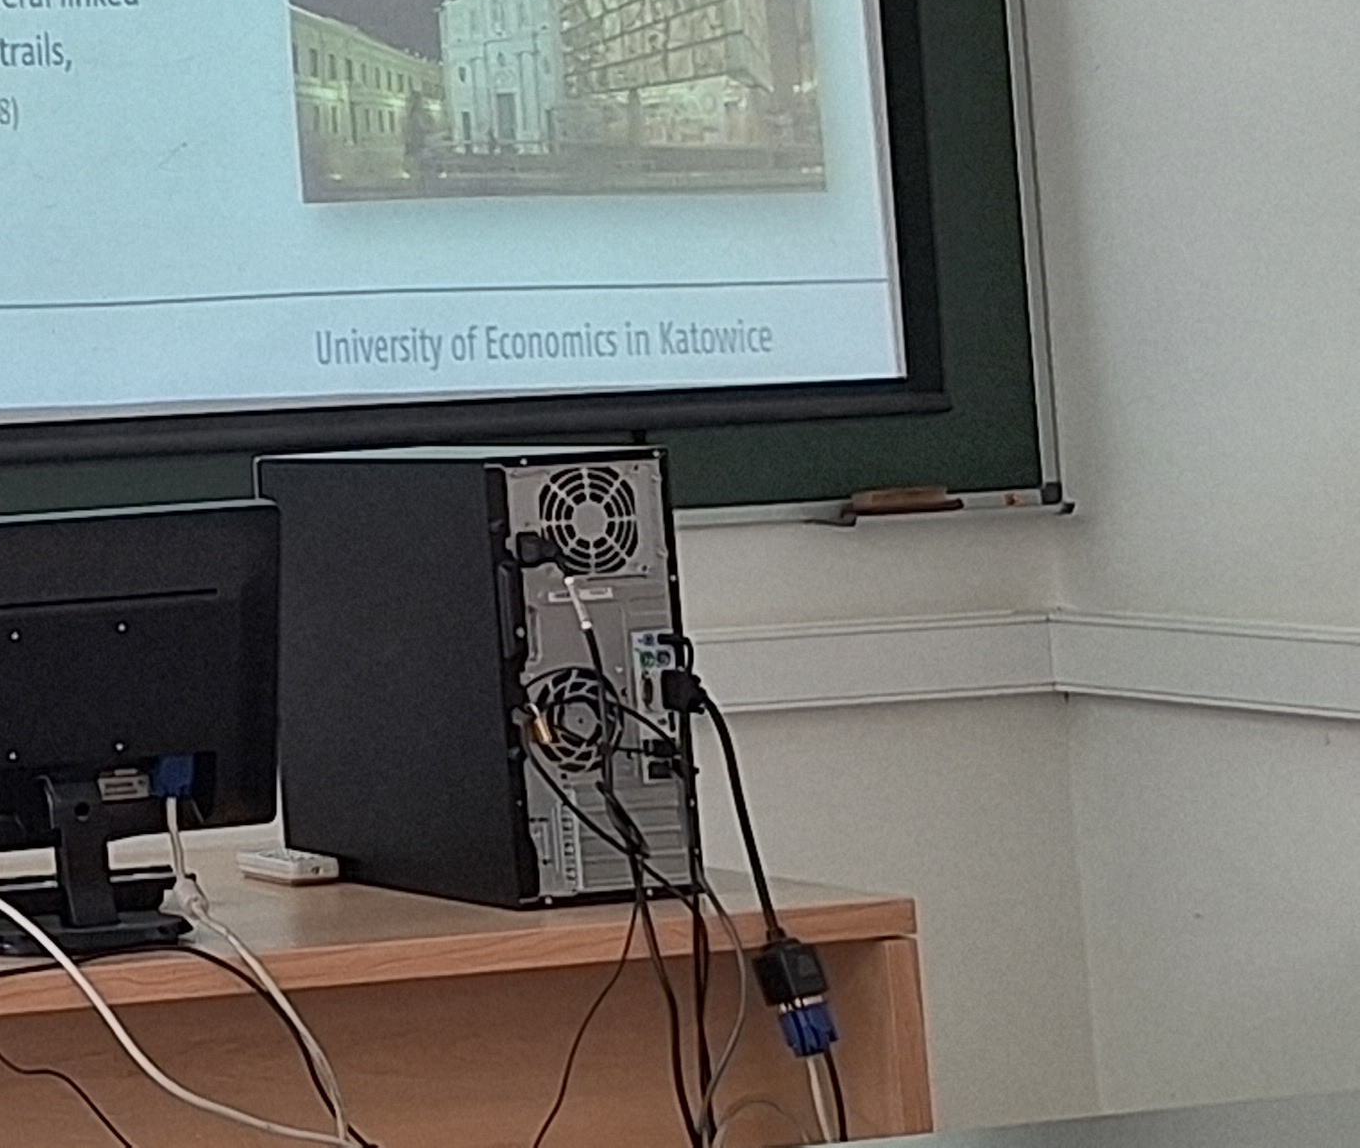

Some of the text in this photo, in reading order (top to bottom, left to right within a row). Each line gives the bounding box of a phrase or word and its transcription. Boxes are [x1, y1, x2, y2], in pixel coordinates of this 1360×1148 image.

[315, 318, 773, 372] University of Economics in Katowice
